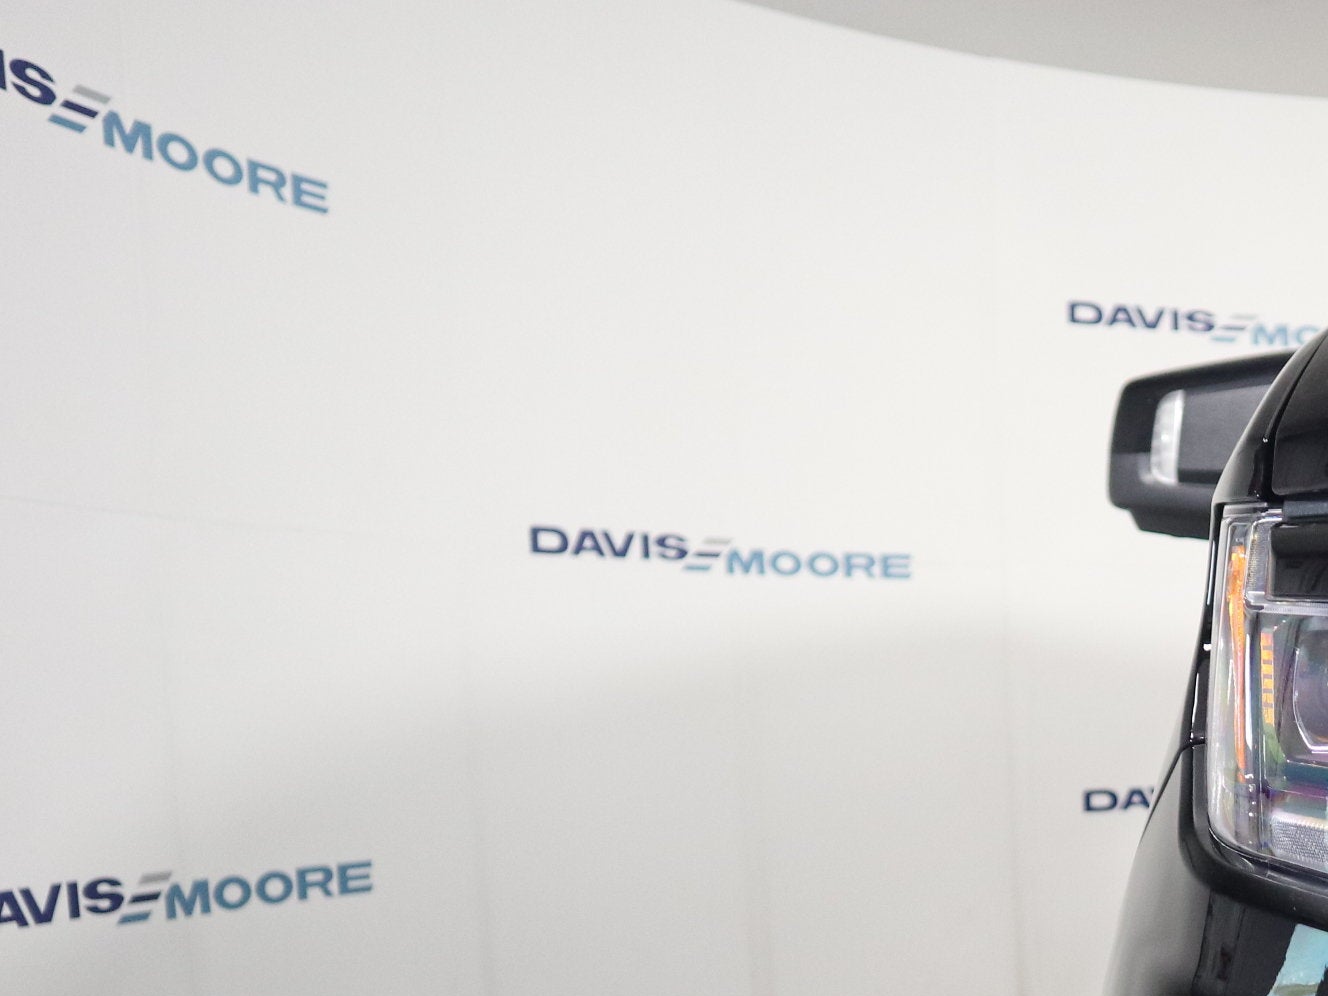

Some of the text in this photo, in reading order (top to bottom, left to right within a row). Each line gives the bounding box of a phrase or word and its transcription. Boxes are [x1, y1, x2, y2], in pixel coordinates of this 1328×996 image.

[102, 110, 329, 214] MOORE
[1068, 300, 1216, 332] DAVIS
[529, 526, 912, 580] DAVIS MOORE
[1083, 787, 1155, 812] DA
[164, 860, 373, 921] MOORE
